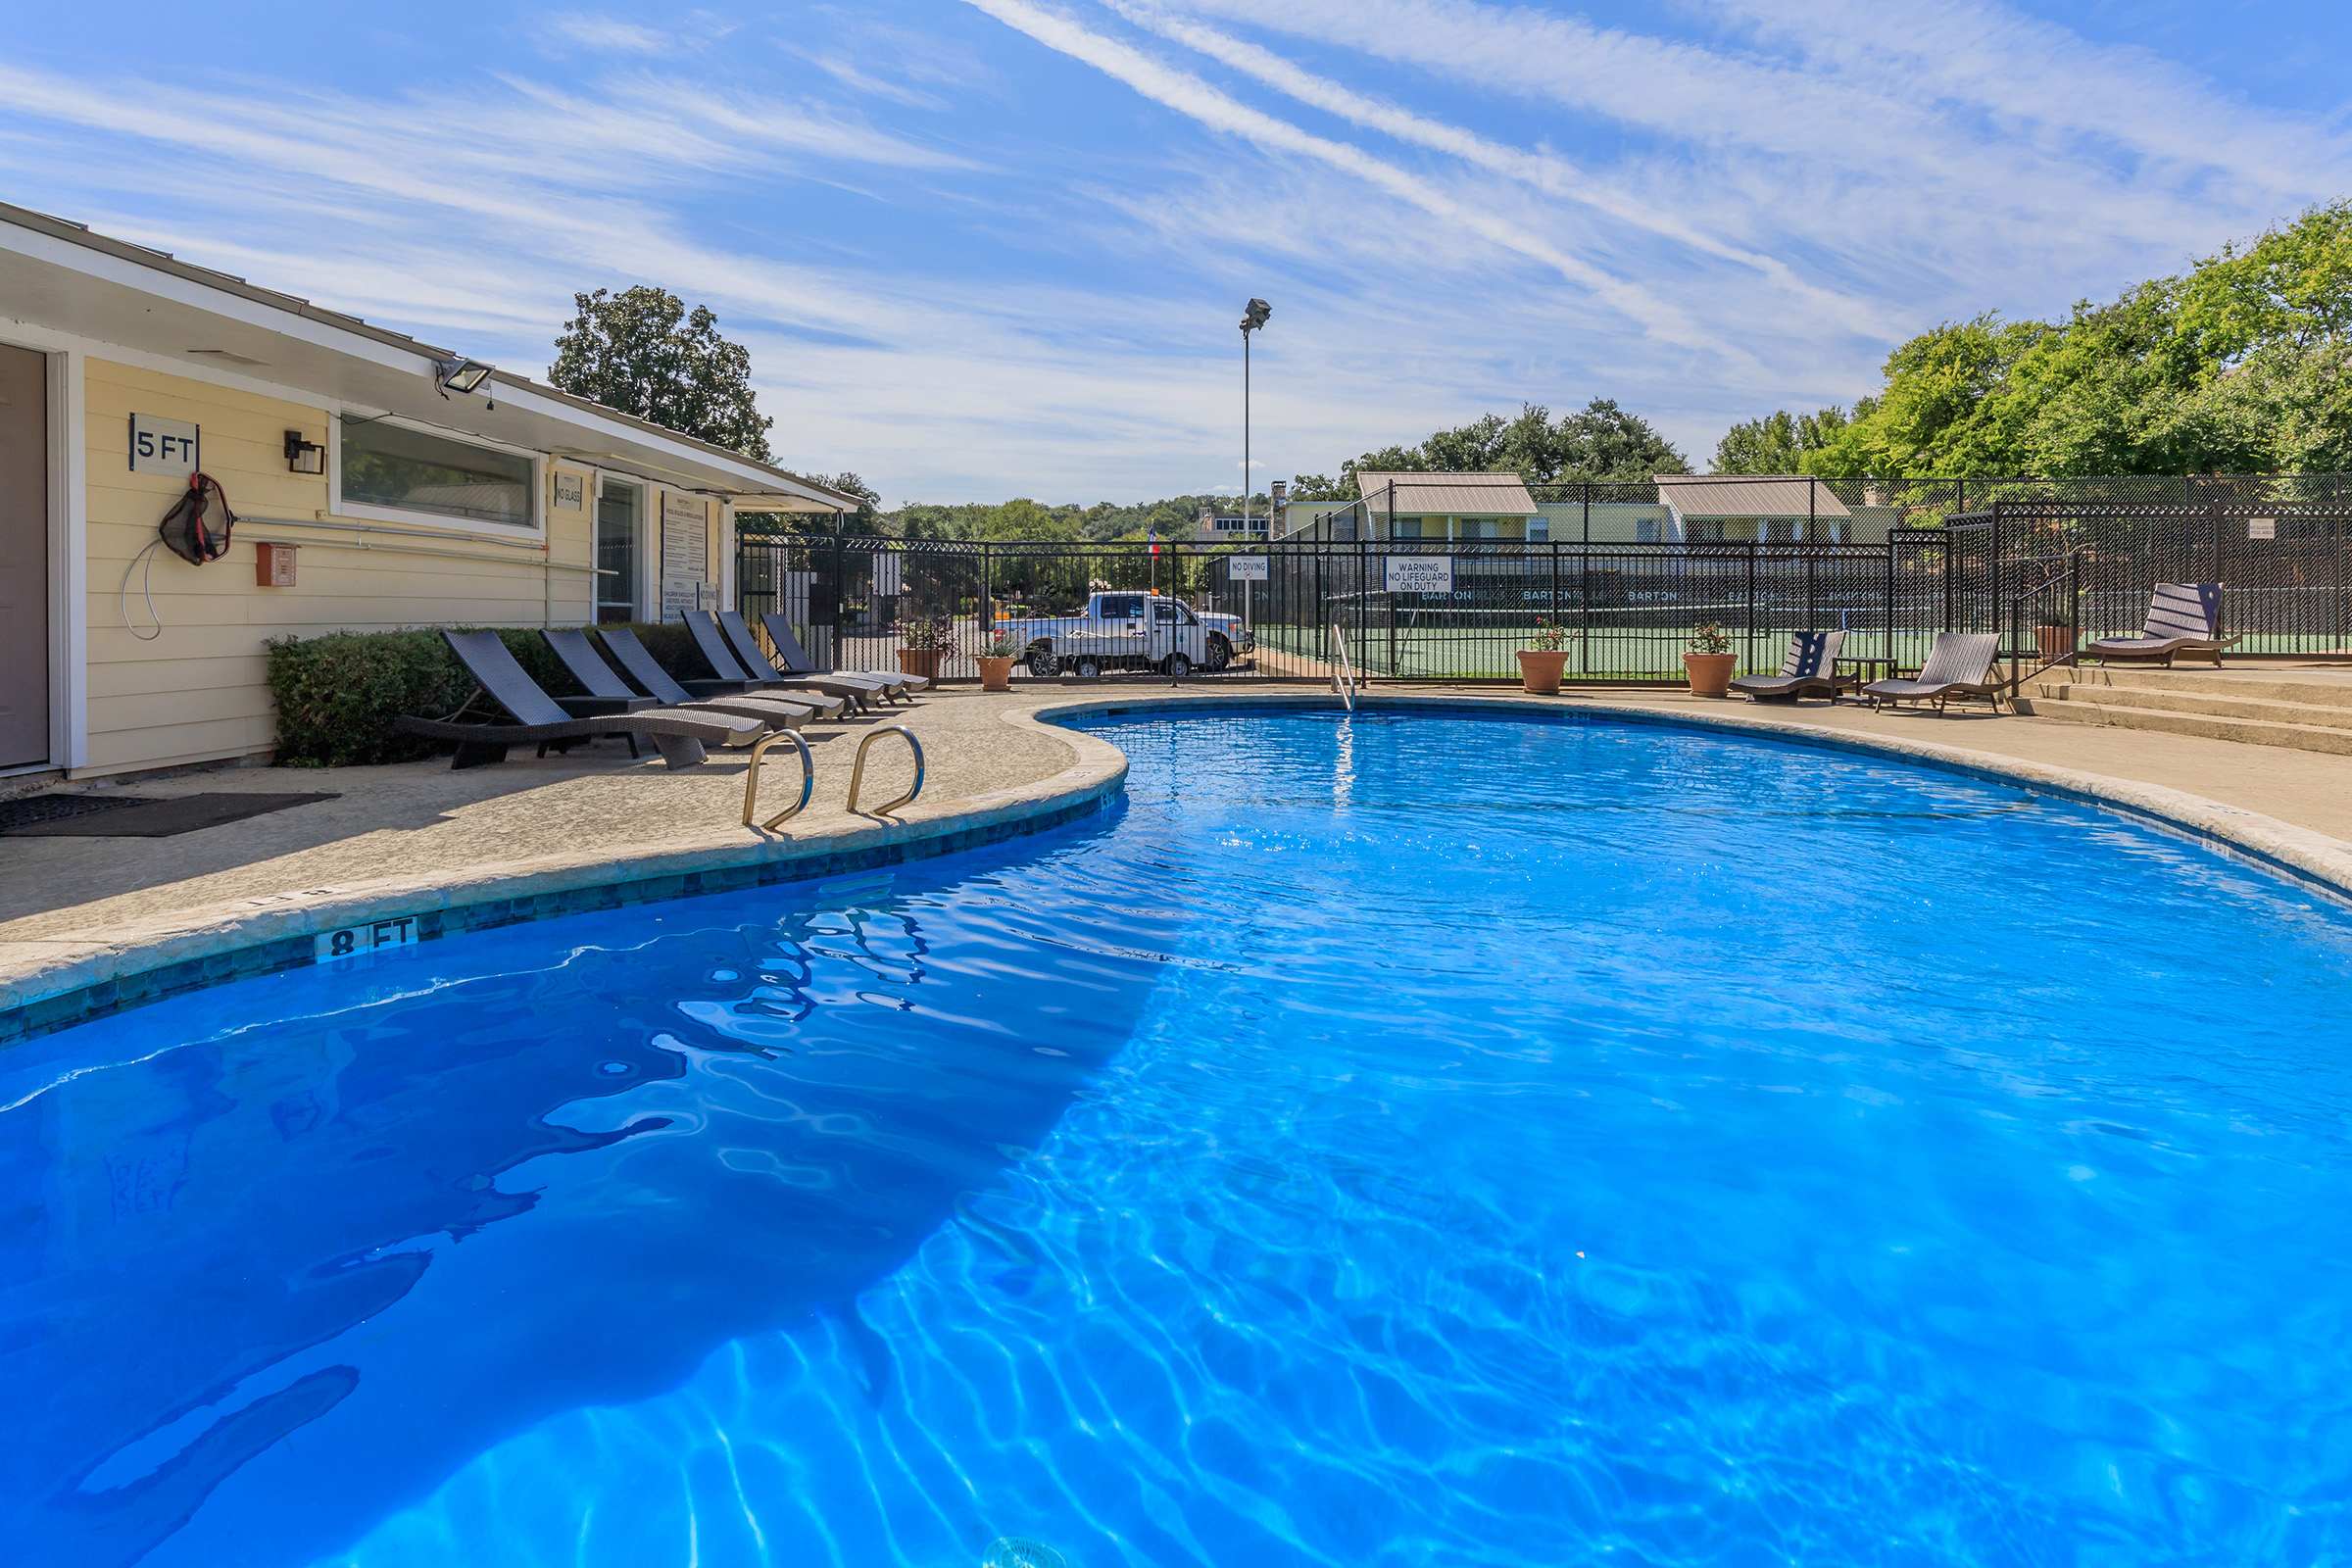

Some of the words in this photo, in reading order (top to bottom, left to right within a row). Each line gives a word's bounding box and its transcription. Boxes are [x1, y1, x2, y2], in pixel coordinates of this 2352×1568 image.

[137, 431, 154, 458] 5
[162, 435, 193, 463] FT
[557, 487, 564, 500] NO
[564, 488, 580, 502] GLASS
[1232, 562, 1243, 571] NO
[1243, 562, 1266, 571] DIVING
[1398, 563, 1440, 572] WARNING
[1388, 572, 1401, 582] NO
[1402, 572, 1449, 582] LIFEGUARD
[1399, 581, 1413, 591] ON
[1414, 581, 1438, 591] DUTY
[1221, 591, 1269, 601] BARON
[1627, 591, 1678, 601] BARTON
[330, 930, 355, 956] 8
[372, 918, 414, 949] FT
